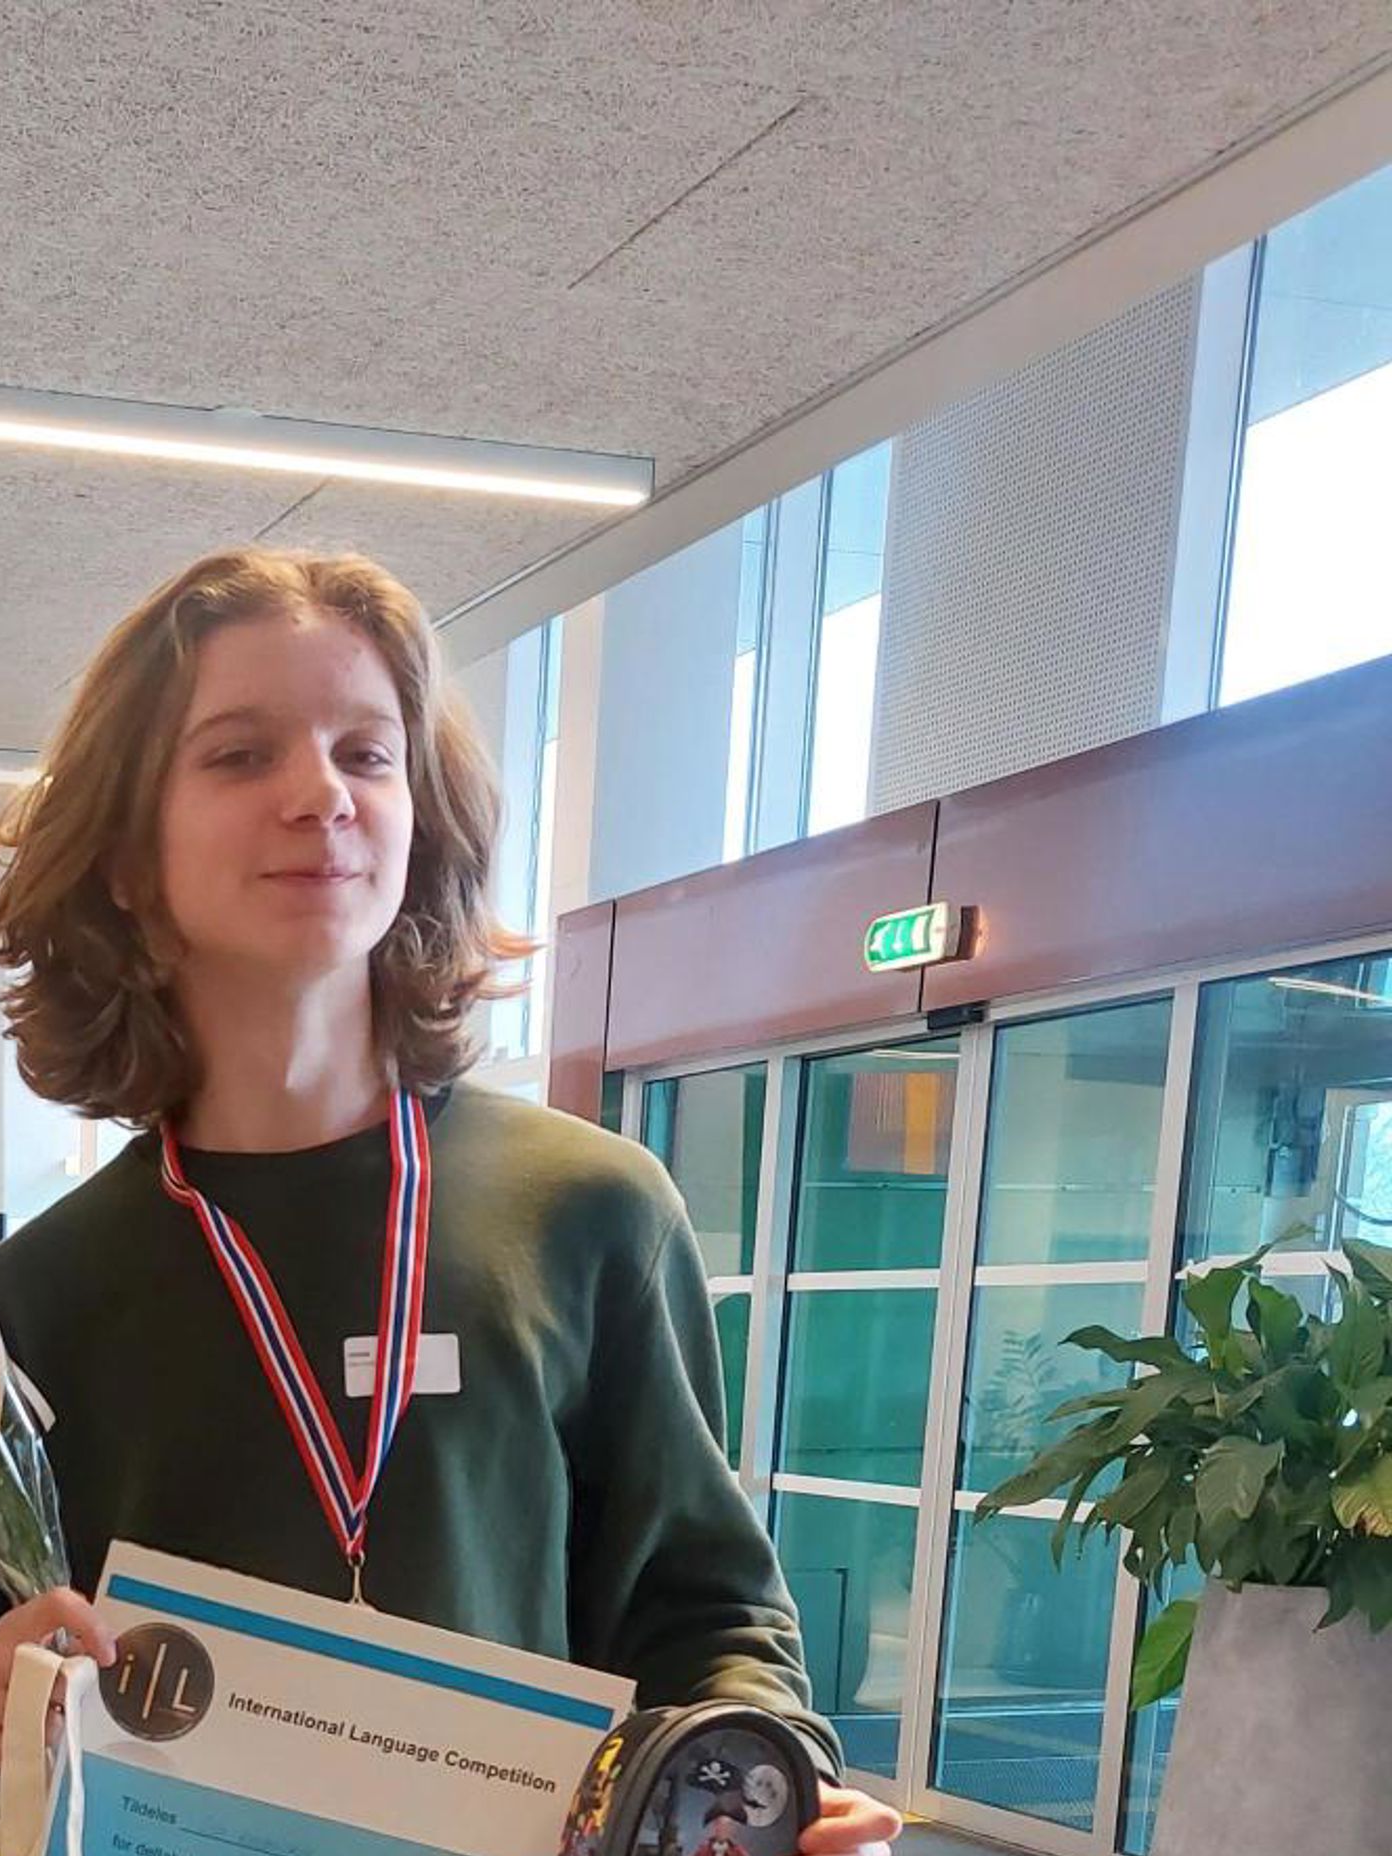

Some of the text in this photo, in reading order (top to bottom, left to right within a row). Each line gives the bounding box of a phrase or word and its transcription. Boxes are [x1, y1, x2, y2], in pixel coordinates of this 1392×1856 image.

[228, 1691, 557, 1794] International Language Competition
[121, 1795, 178, 1826] Tildeles
